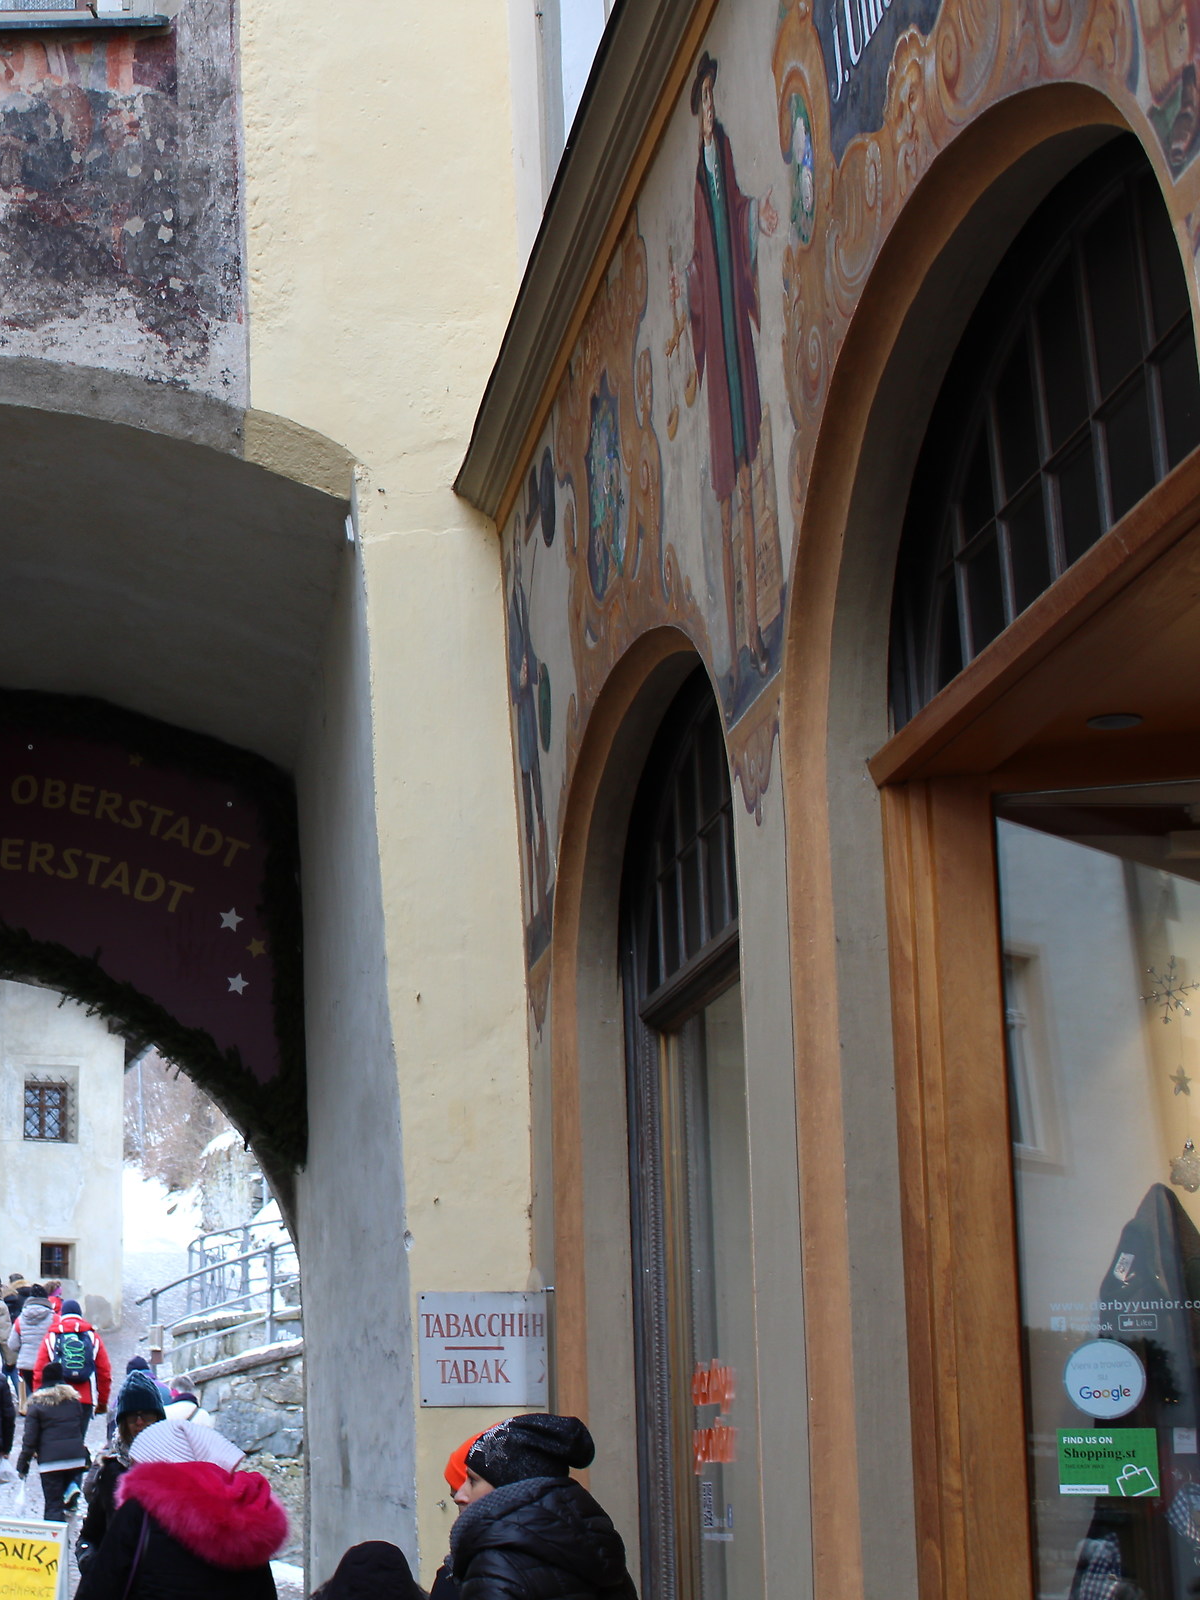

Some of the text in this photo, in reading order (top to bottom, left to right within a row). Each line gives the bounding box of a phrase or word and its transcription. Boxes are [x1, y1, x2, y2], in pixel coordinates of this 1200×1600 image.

[11, 775, 250, 868] OBERSTADT
[436, 1359, 512, 1384] TABAK
[1079, 1385, 1131, 1401] Google
[1062, 1436, 1113, 1444] FIND US ON
[1064, 1447, 1136, 1461] Shopping.st
